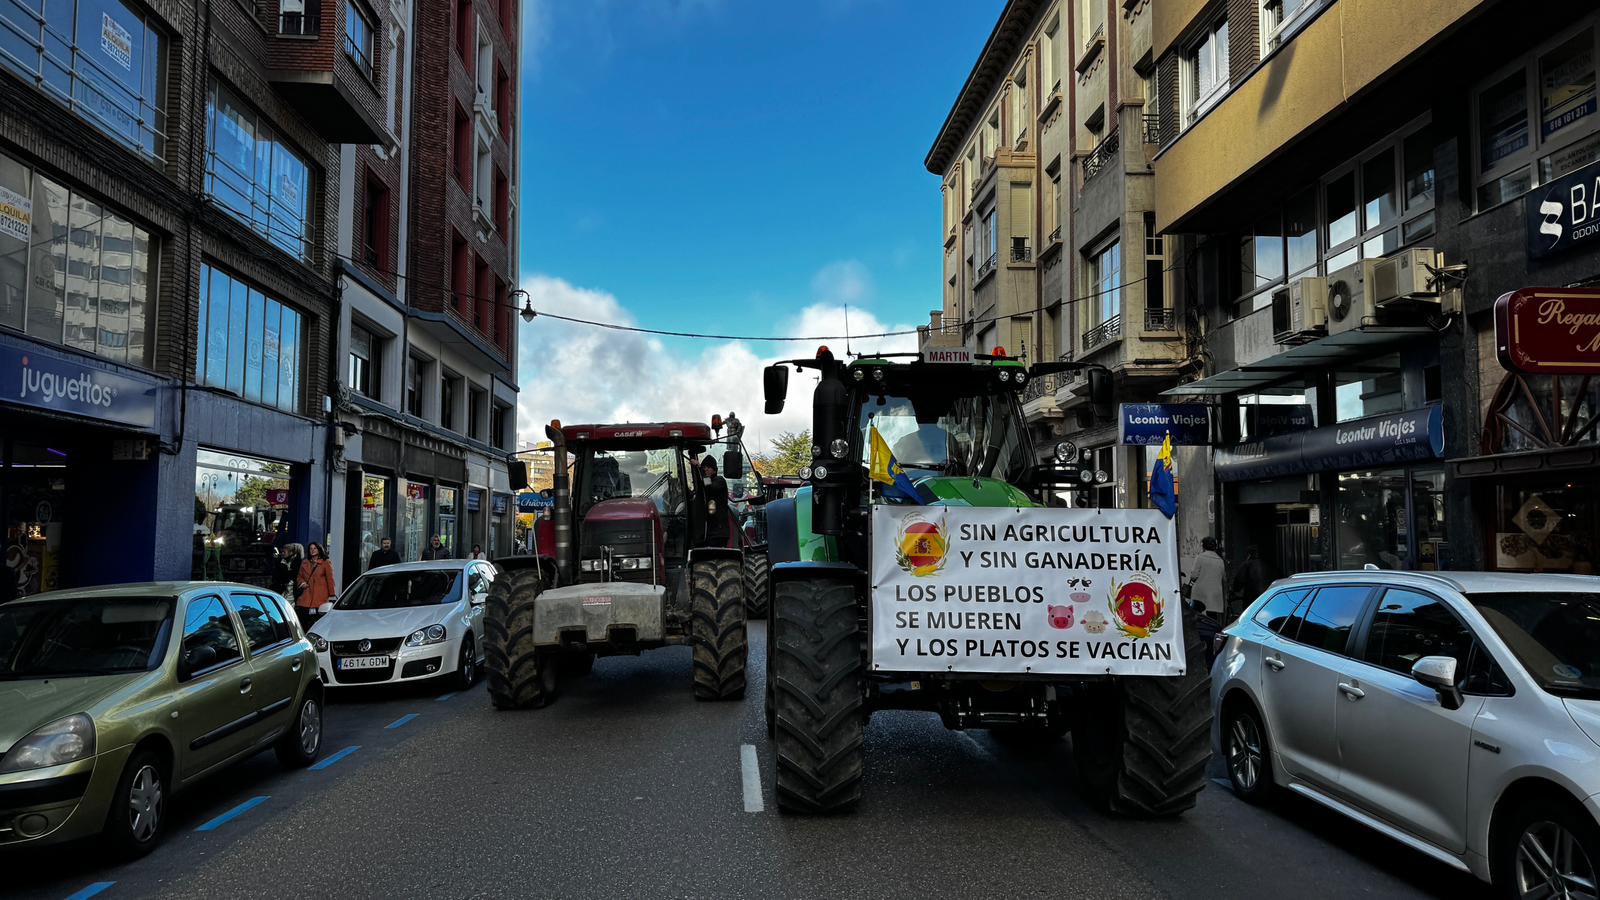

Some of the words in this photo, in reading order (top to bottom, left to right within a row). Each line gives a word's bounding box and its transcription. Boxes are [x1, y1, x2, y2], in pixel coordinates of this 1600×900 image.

[1572, 222, 1600, 240] ODON
[929, 351, 970, 362] MARTIN
[20, 356, 112, 407] juguettos
[1129, 415, 1170, 425] Leontur
[1172, 414, 1207, 428] Viajes
[1336, 426, 1377, 445] Leontur
[1378, 418, 1416, 440] Viajes
[960, 523, 996, 541] SIN
[1003, 524, 1161, 544] AGRICULTURA
[959, 551, 974, 568] Y
[980, 551, 1017, 569] SIN
[1025, 549, 1162, 575] GANADERÍA,
[895, 584, 937, 603] LOS
[944, 585, 1044, 604] PUEBLOS
[895, 611, 920, 629] SE
[927, 611, 1021, 630] MUEREN
[896, 638, 910, 656] Y
[917, 638, 958, 657] LOS
[965, 639, 1050, 659] PLATOS
[1056, 640, 1080, 659] SE
[1086, 637, 1172, 661] VACÍAN
[343, 658, 366, 669] 4614
[369, 657, 388, 667] GDM
